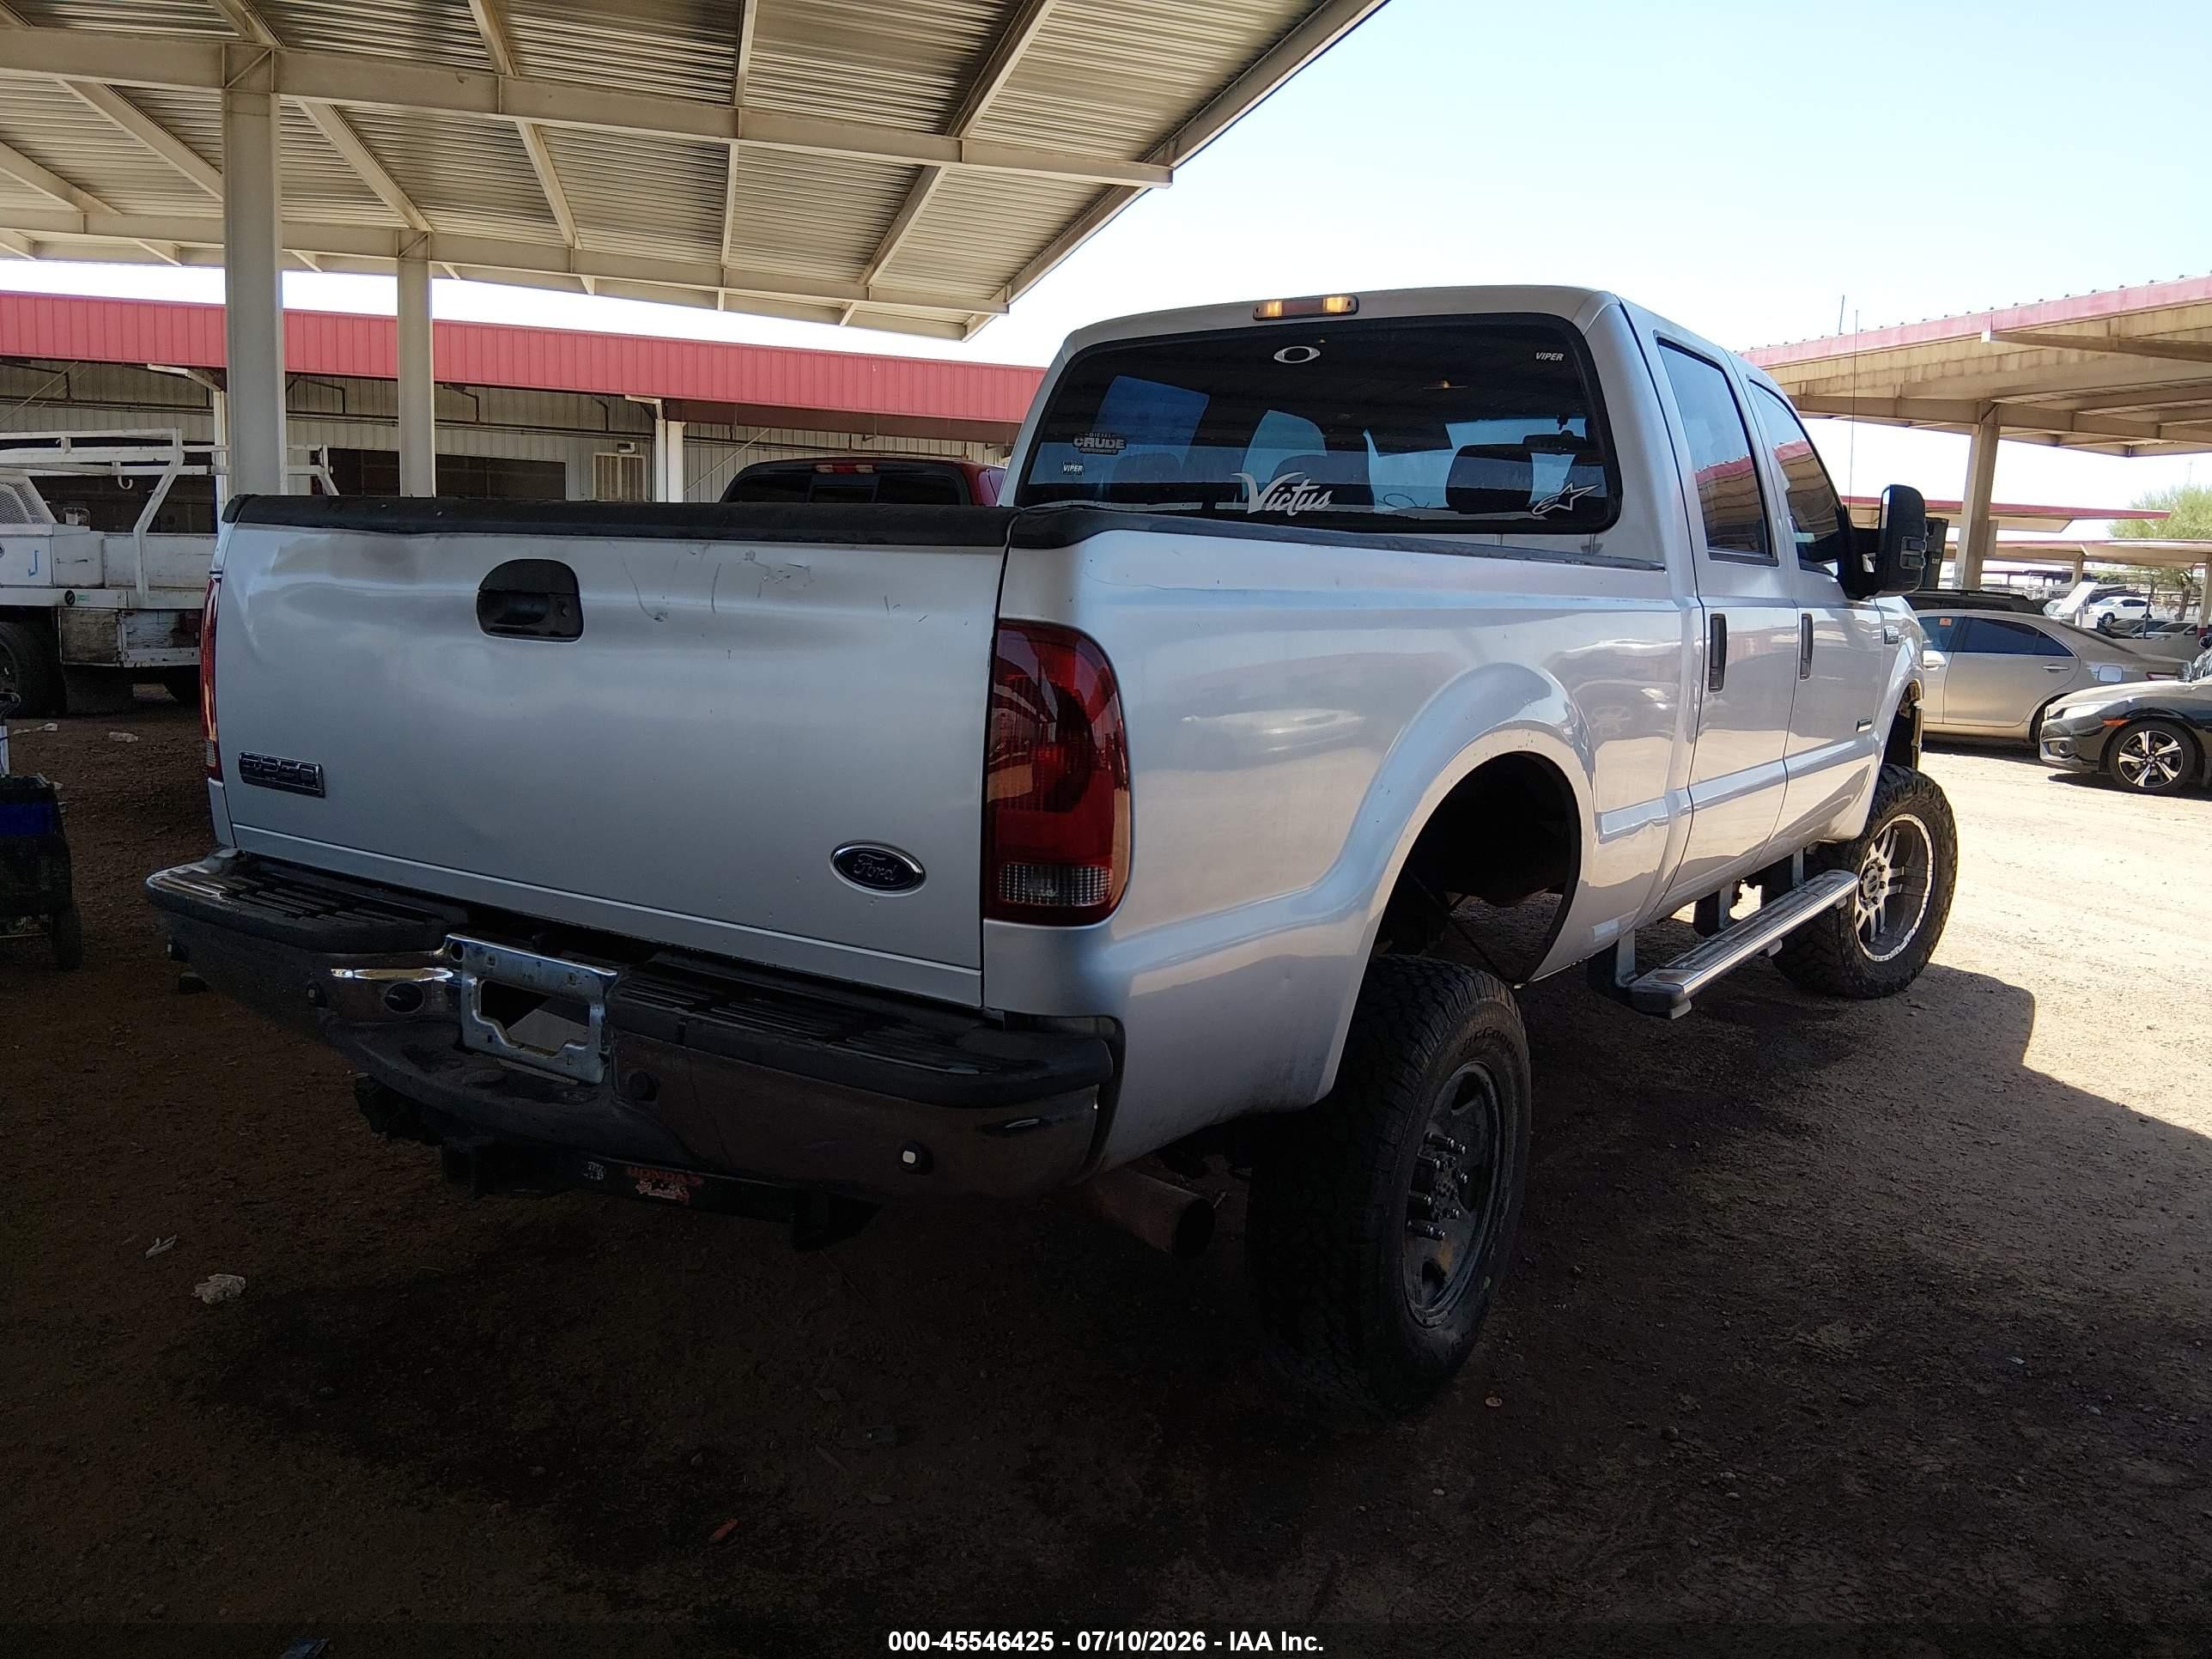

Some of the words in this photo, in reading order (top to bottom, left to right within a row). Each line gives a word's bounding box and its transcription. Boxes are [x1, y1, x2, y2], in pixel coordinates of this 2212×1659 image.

[1535, 351, 1565, 362] VIPER
[1073, 436, 1126, 449] CRUDE
[1063, 464, 1084, 472] VIPER
[1231, 471, 1334, 517] Victus
[853, 853, 898, 882] Ford
